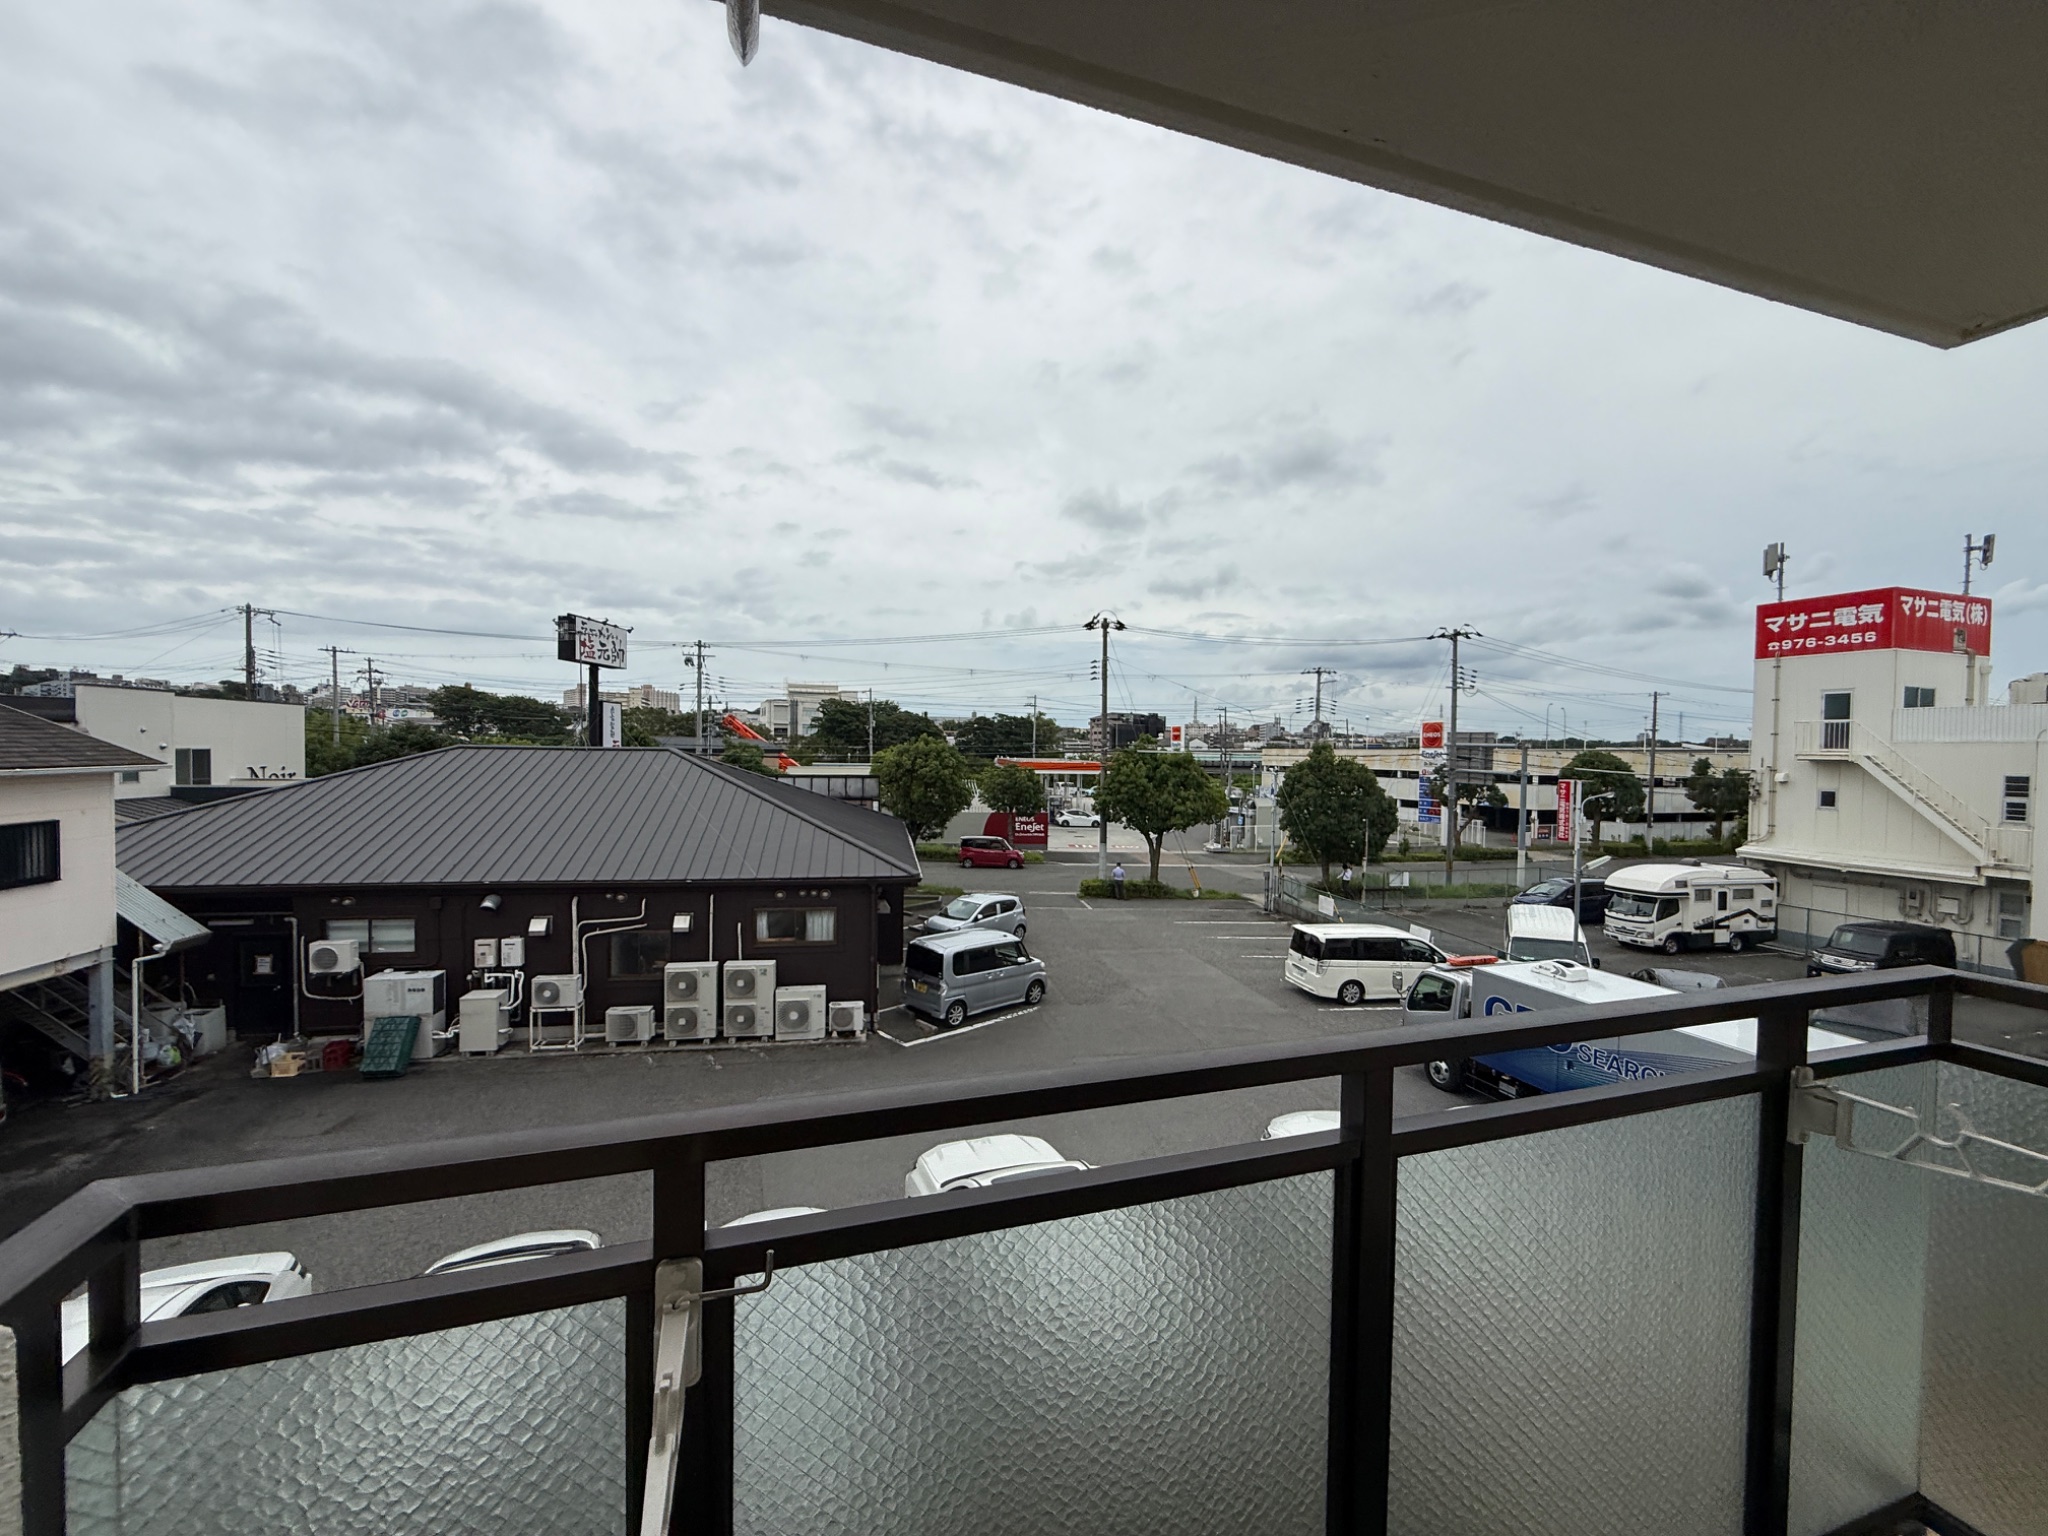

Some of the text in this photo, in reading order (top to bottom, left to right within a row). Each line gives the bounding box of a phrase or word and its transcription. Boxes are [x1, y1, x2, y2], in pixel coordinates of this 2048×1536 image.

[1764, 603, 1885, 632] マサニ電気
[1901, 595, 1988, 626] マサニ電気(株)
[1781, 631, 1877, 650] 976-3456
[1015, 822, 1045, 832] EneJet
[1577, 1043, 1665, 1081] SEARC
